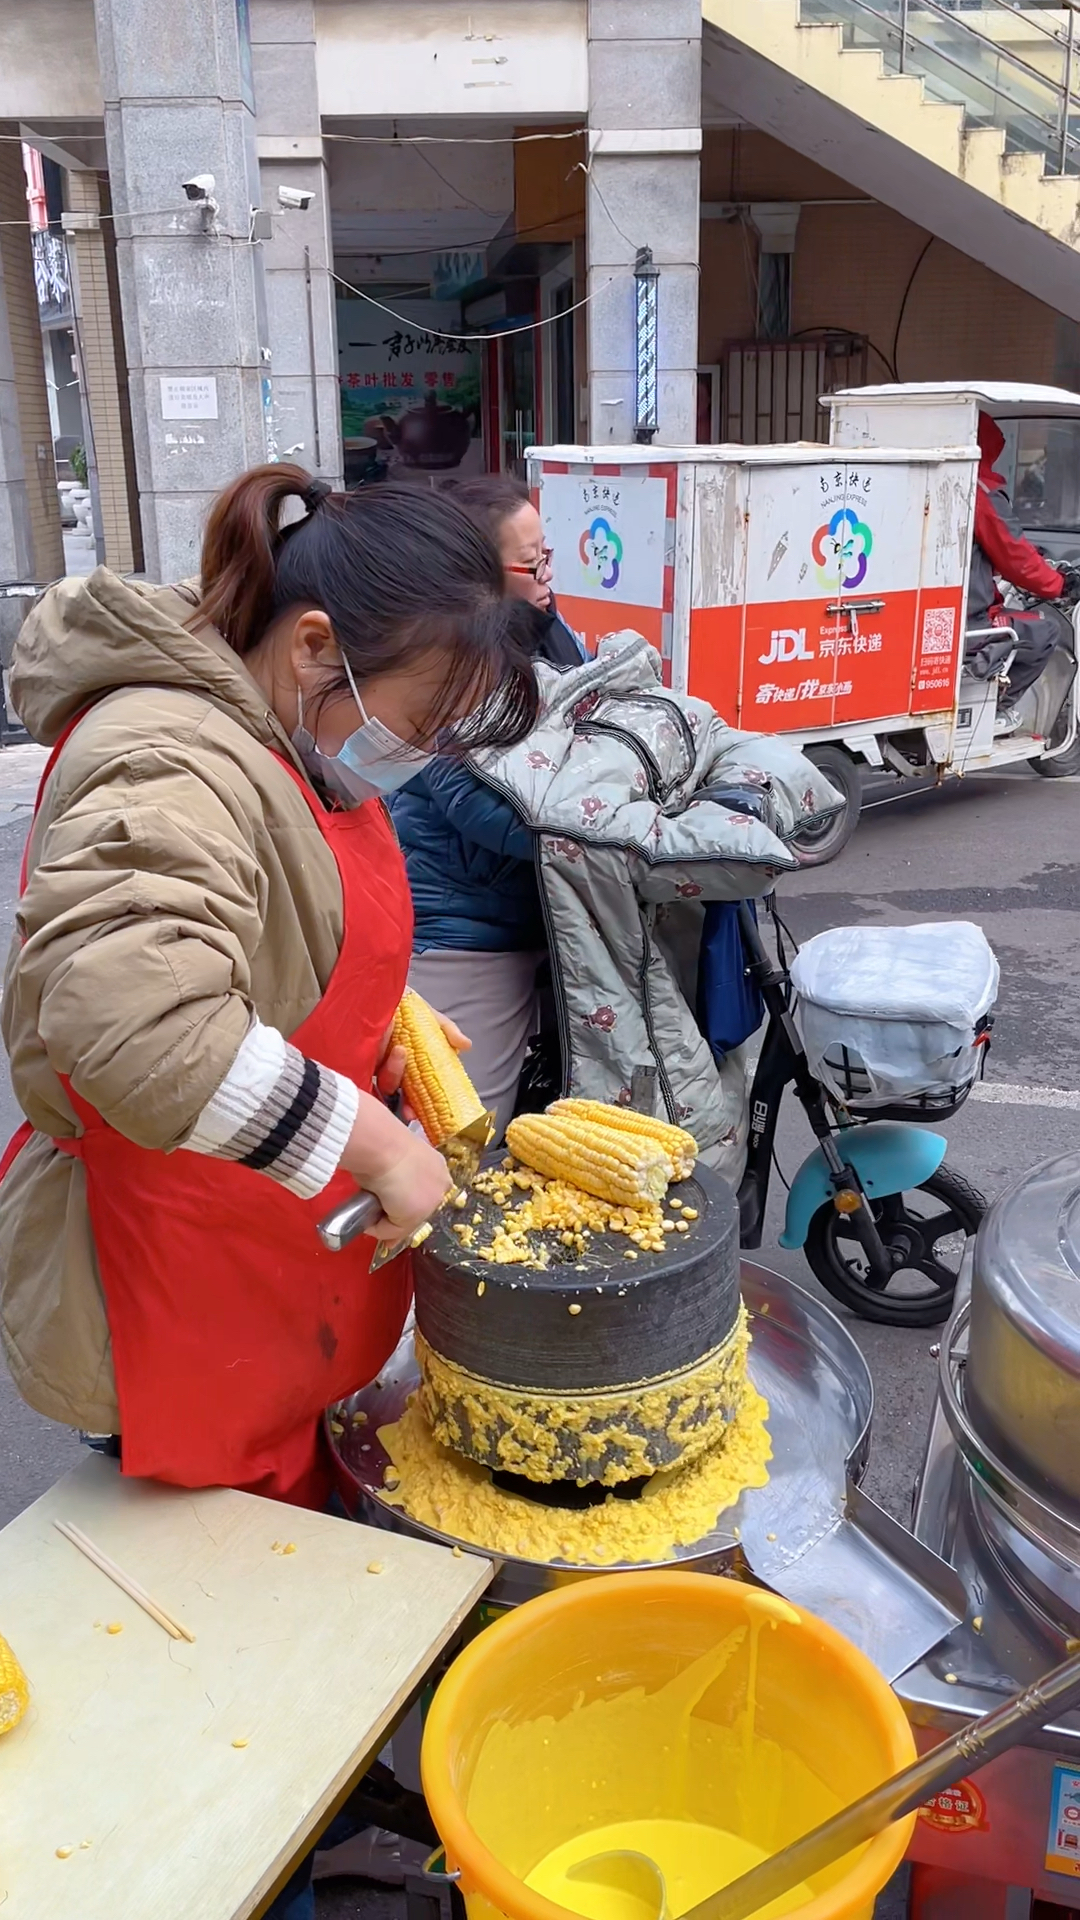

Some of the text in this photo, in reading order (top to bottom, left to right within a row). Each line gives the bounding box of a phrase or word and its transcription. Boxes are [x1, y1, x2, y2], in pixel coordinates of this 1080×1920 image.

[339, 371, 456, 388] 茶叶批发 零售
[820, 493, 868, 509] NANJING EXPRESS
[819, 625, 848, 635] Express
[758, 627, 815, 665] JDL
[818, 633, 883, 658] 京东快递
[925, 678, 950, 689] 950616
